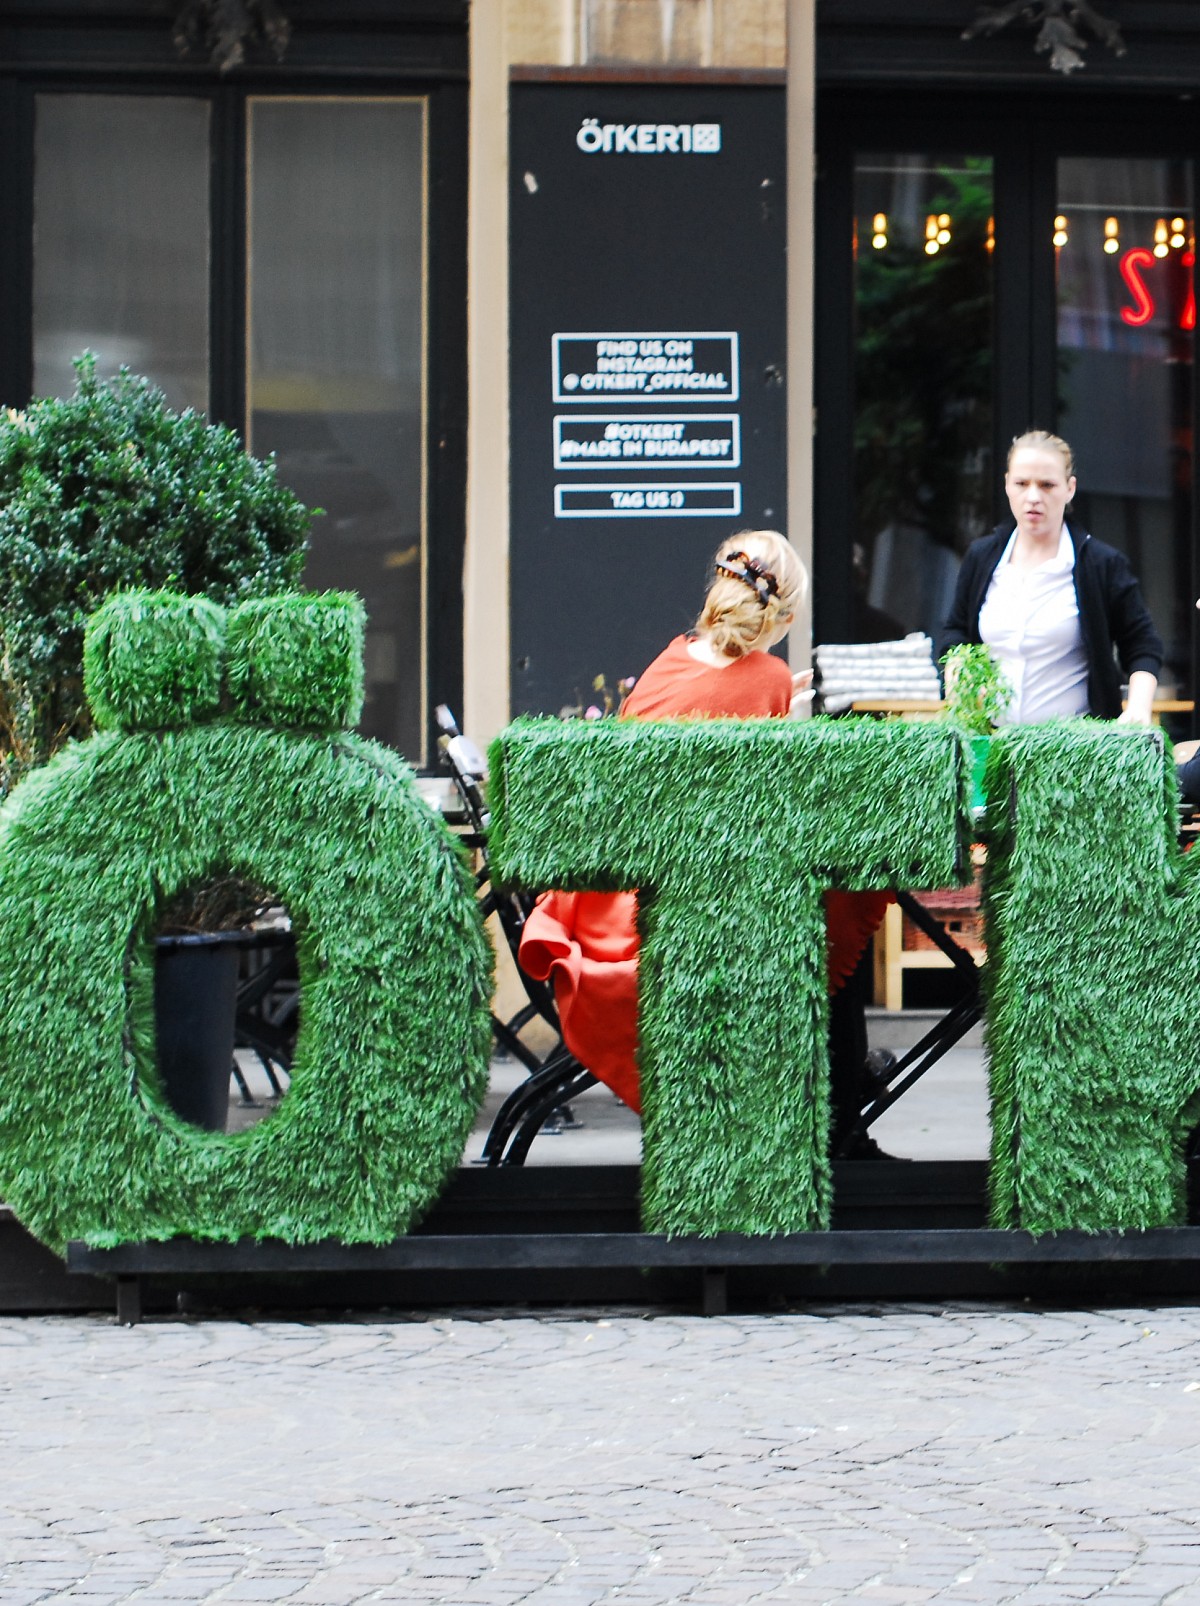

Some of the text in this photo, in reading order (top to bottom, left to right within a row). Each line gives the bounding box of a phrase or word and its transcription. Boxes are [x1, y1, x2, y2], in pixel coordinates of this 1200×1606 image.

[597, 340, 693, 356] FIND US ON
[597, 357, 693, 372] INSTAGRAM
[622, 440, 643, 456] IN
[644, 439, 731, 456] BUDAPEST
[610, 491, 645, 508] TAG
[645, 491, 670, 508] US
